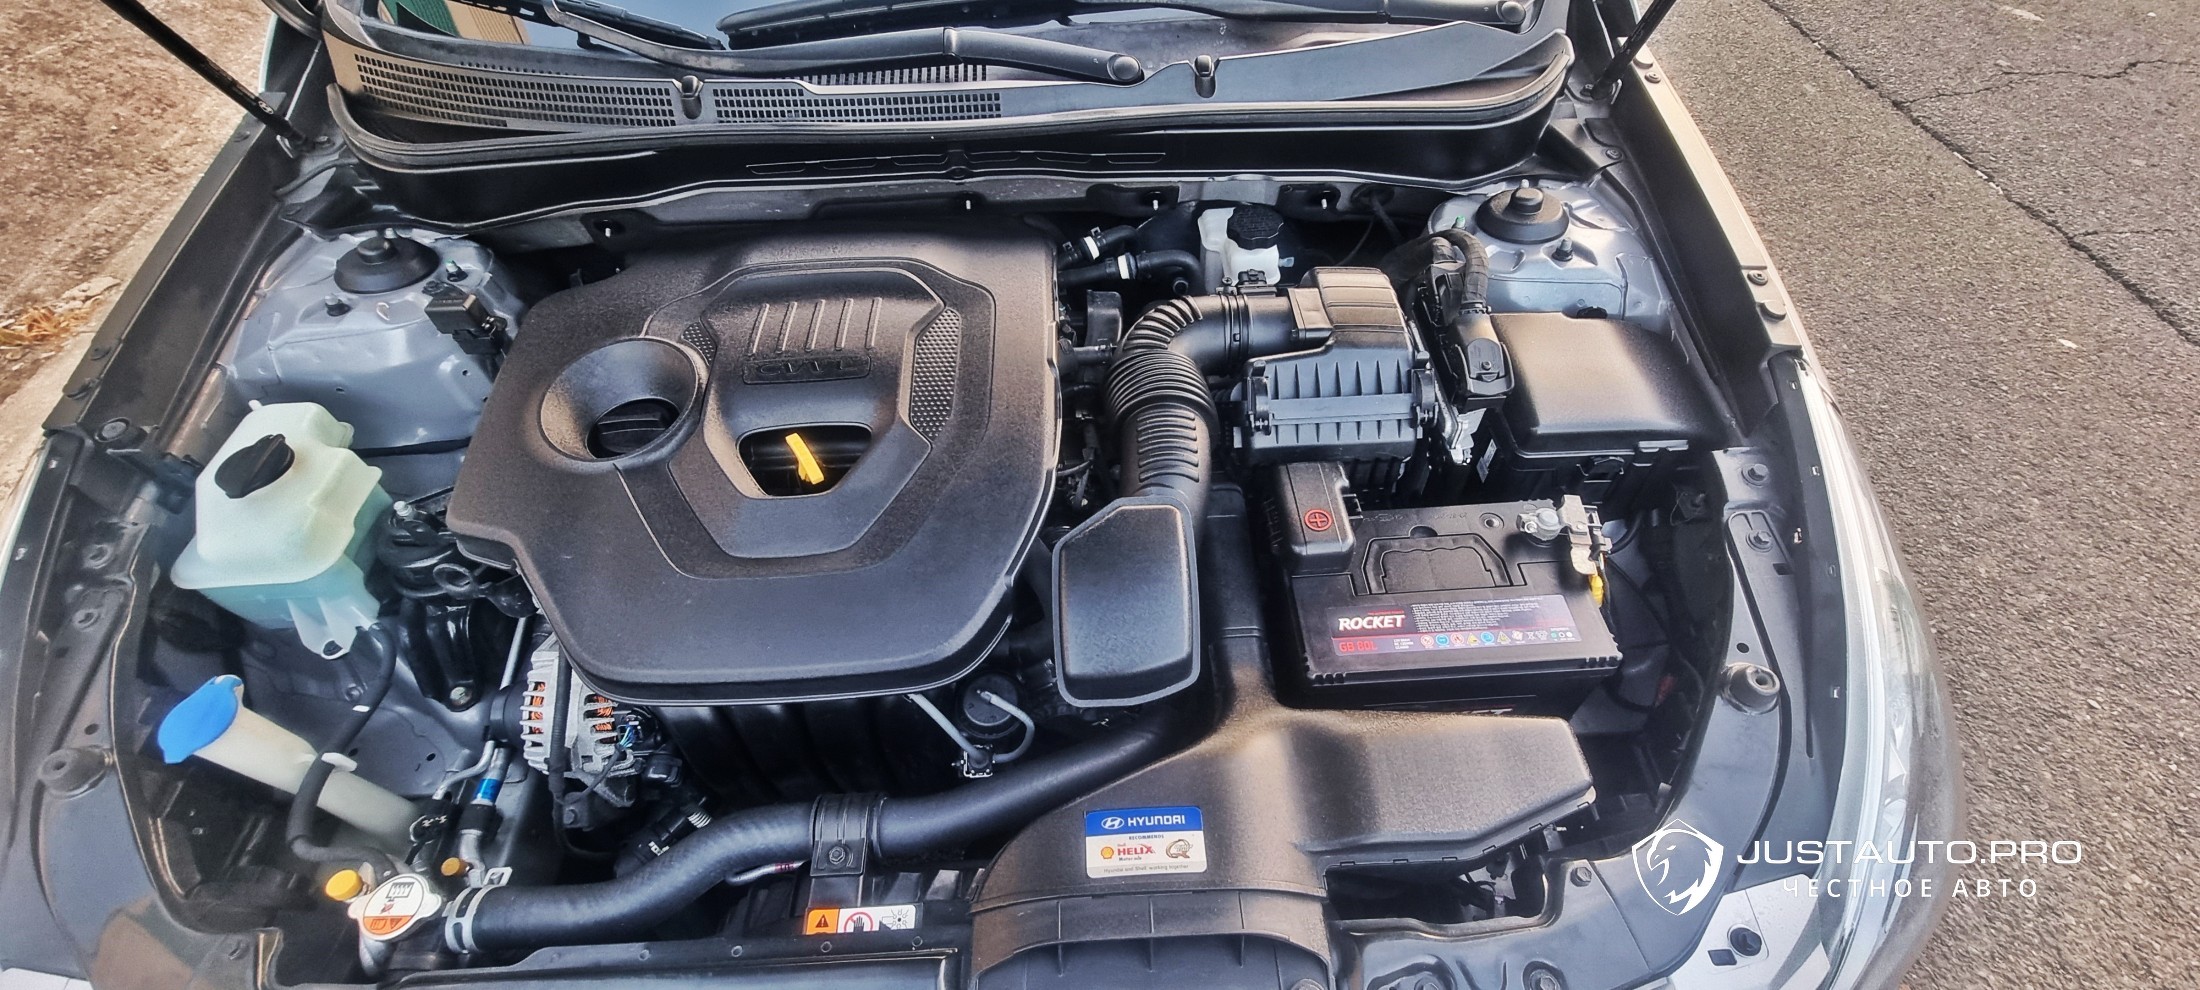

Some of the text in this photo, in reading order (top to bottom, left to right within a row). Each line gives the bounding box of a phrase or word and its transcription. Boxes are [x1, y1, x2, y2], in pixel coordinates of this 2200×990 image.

[1338, 614, 1406, 631] ROCKET
[1339, 641, 1355, 652] GB
[1128, 814, 1185, 826] HYUNDAI
[1117, 846, 1153, 856] HELIX
